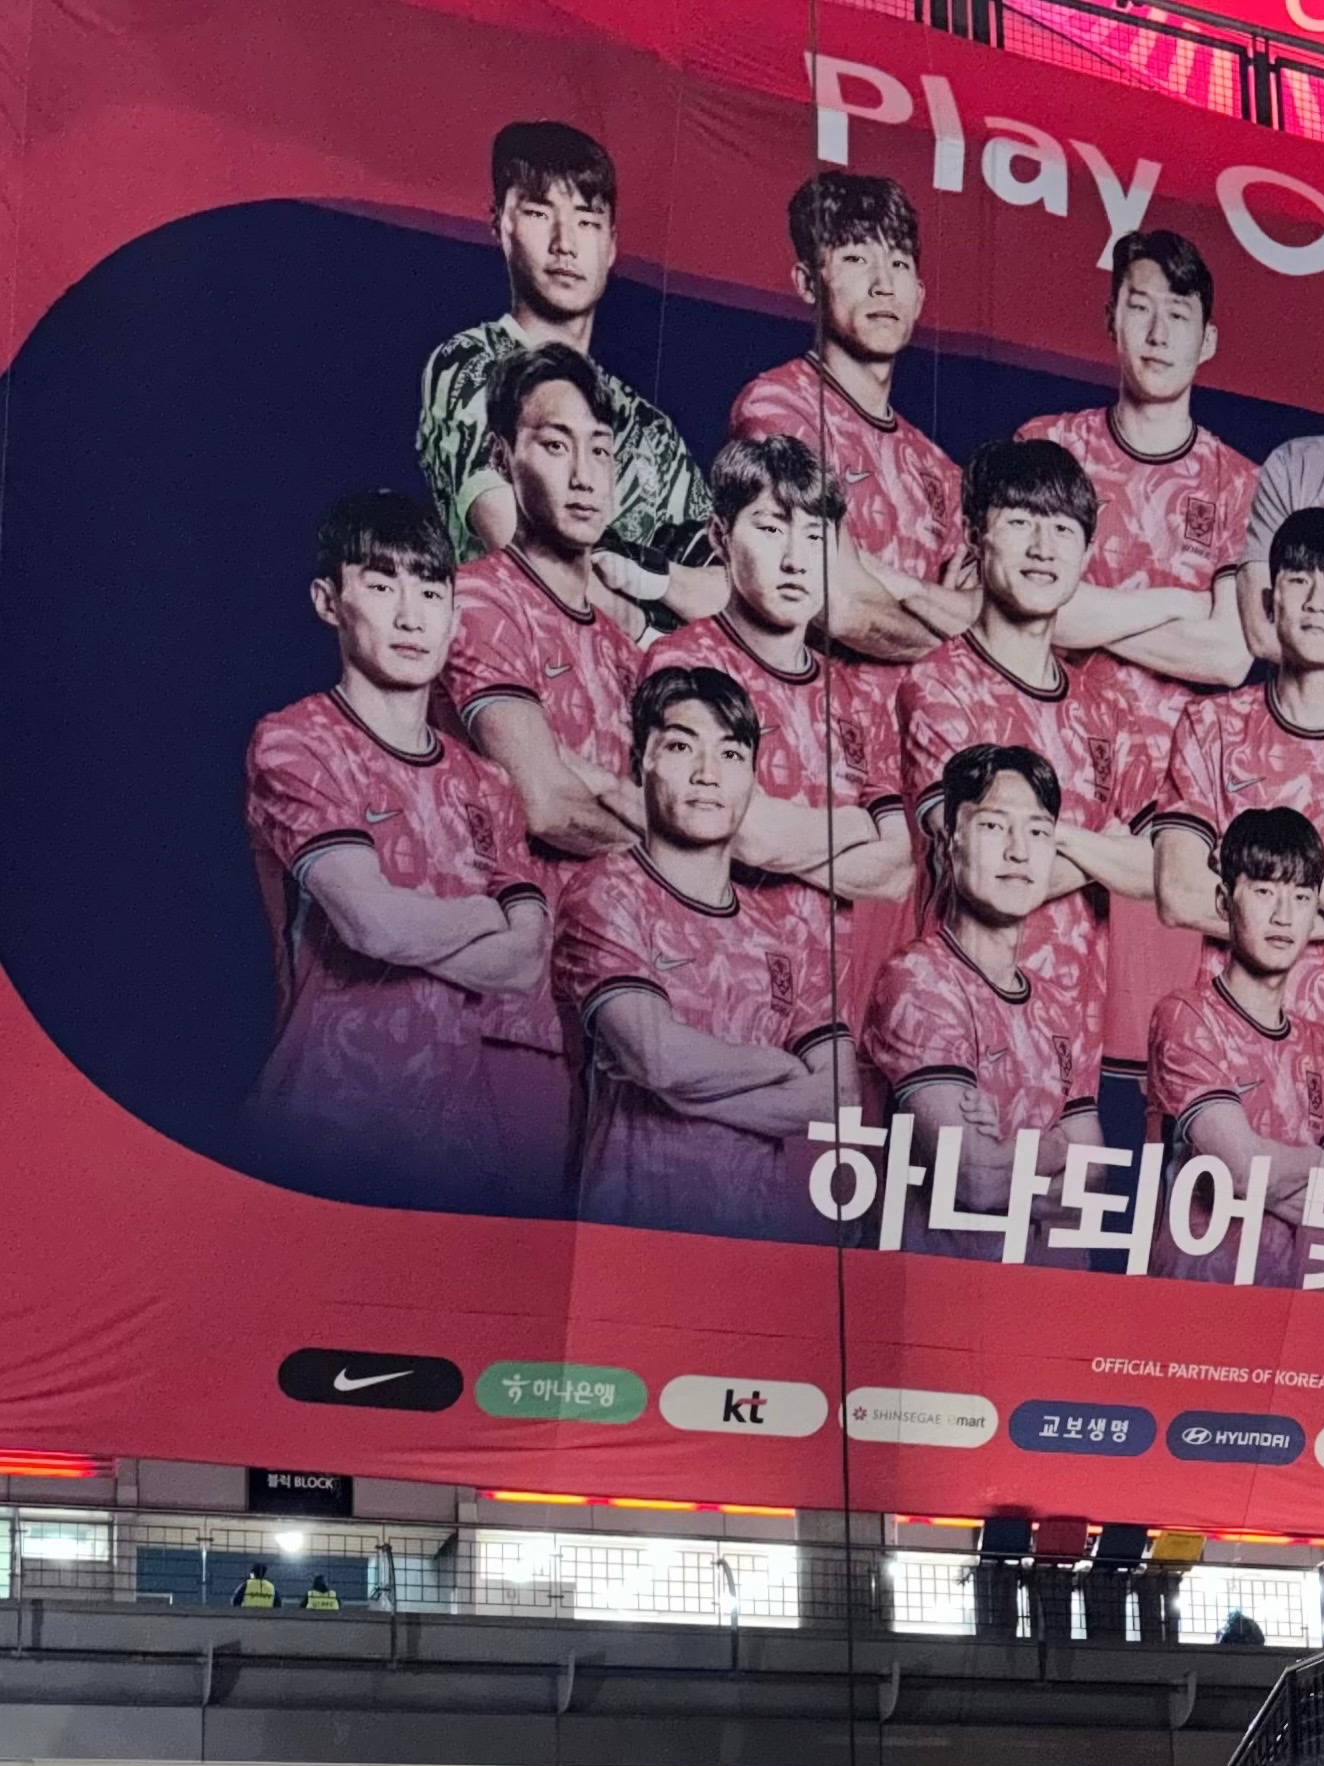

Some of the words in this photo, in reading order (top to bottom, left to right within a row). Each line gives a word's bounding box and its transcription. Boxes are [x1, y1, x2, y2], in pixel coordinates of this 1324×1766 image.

[803, 51, 1165, 272] Play
[806, 1106, 1272, 1286] 하나되어
[1091, 1357, 1164, 1377] OFFICIAL
[1167, 1363, 1249, 1383] PARTNERS
[1251, 1369, 1271, 1384] OF
[534, 1381, 617, 1407] 하나은행
[722, 1390, 769, 1424] kt
[872, 1408, 943, 1426] SHINSEGAE
[946, 1413, 987, 1430] emart
[1038, 1414, 1130, 1443] 교보생명
[1215, 1430, 1291, 1449] HYUNDAI
[294, 1475, 334, 1490] BLOCK
